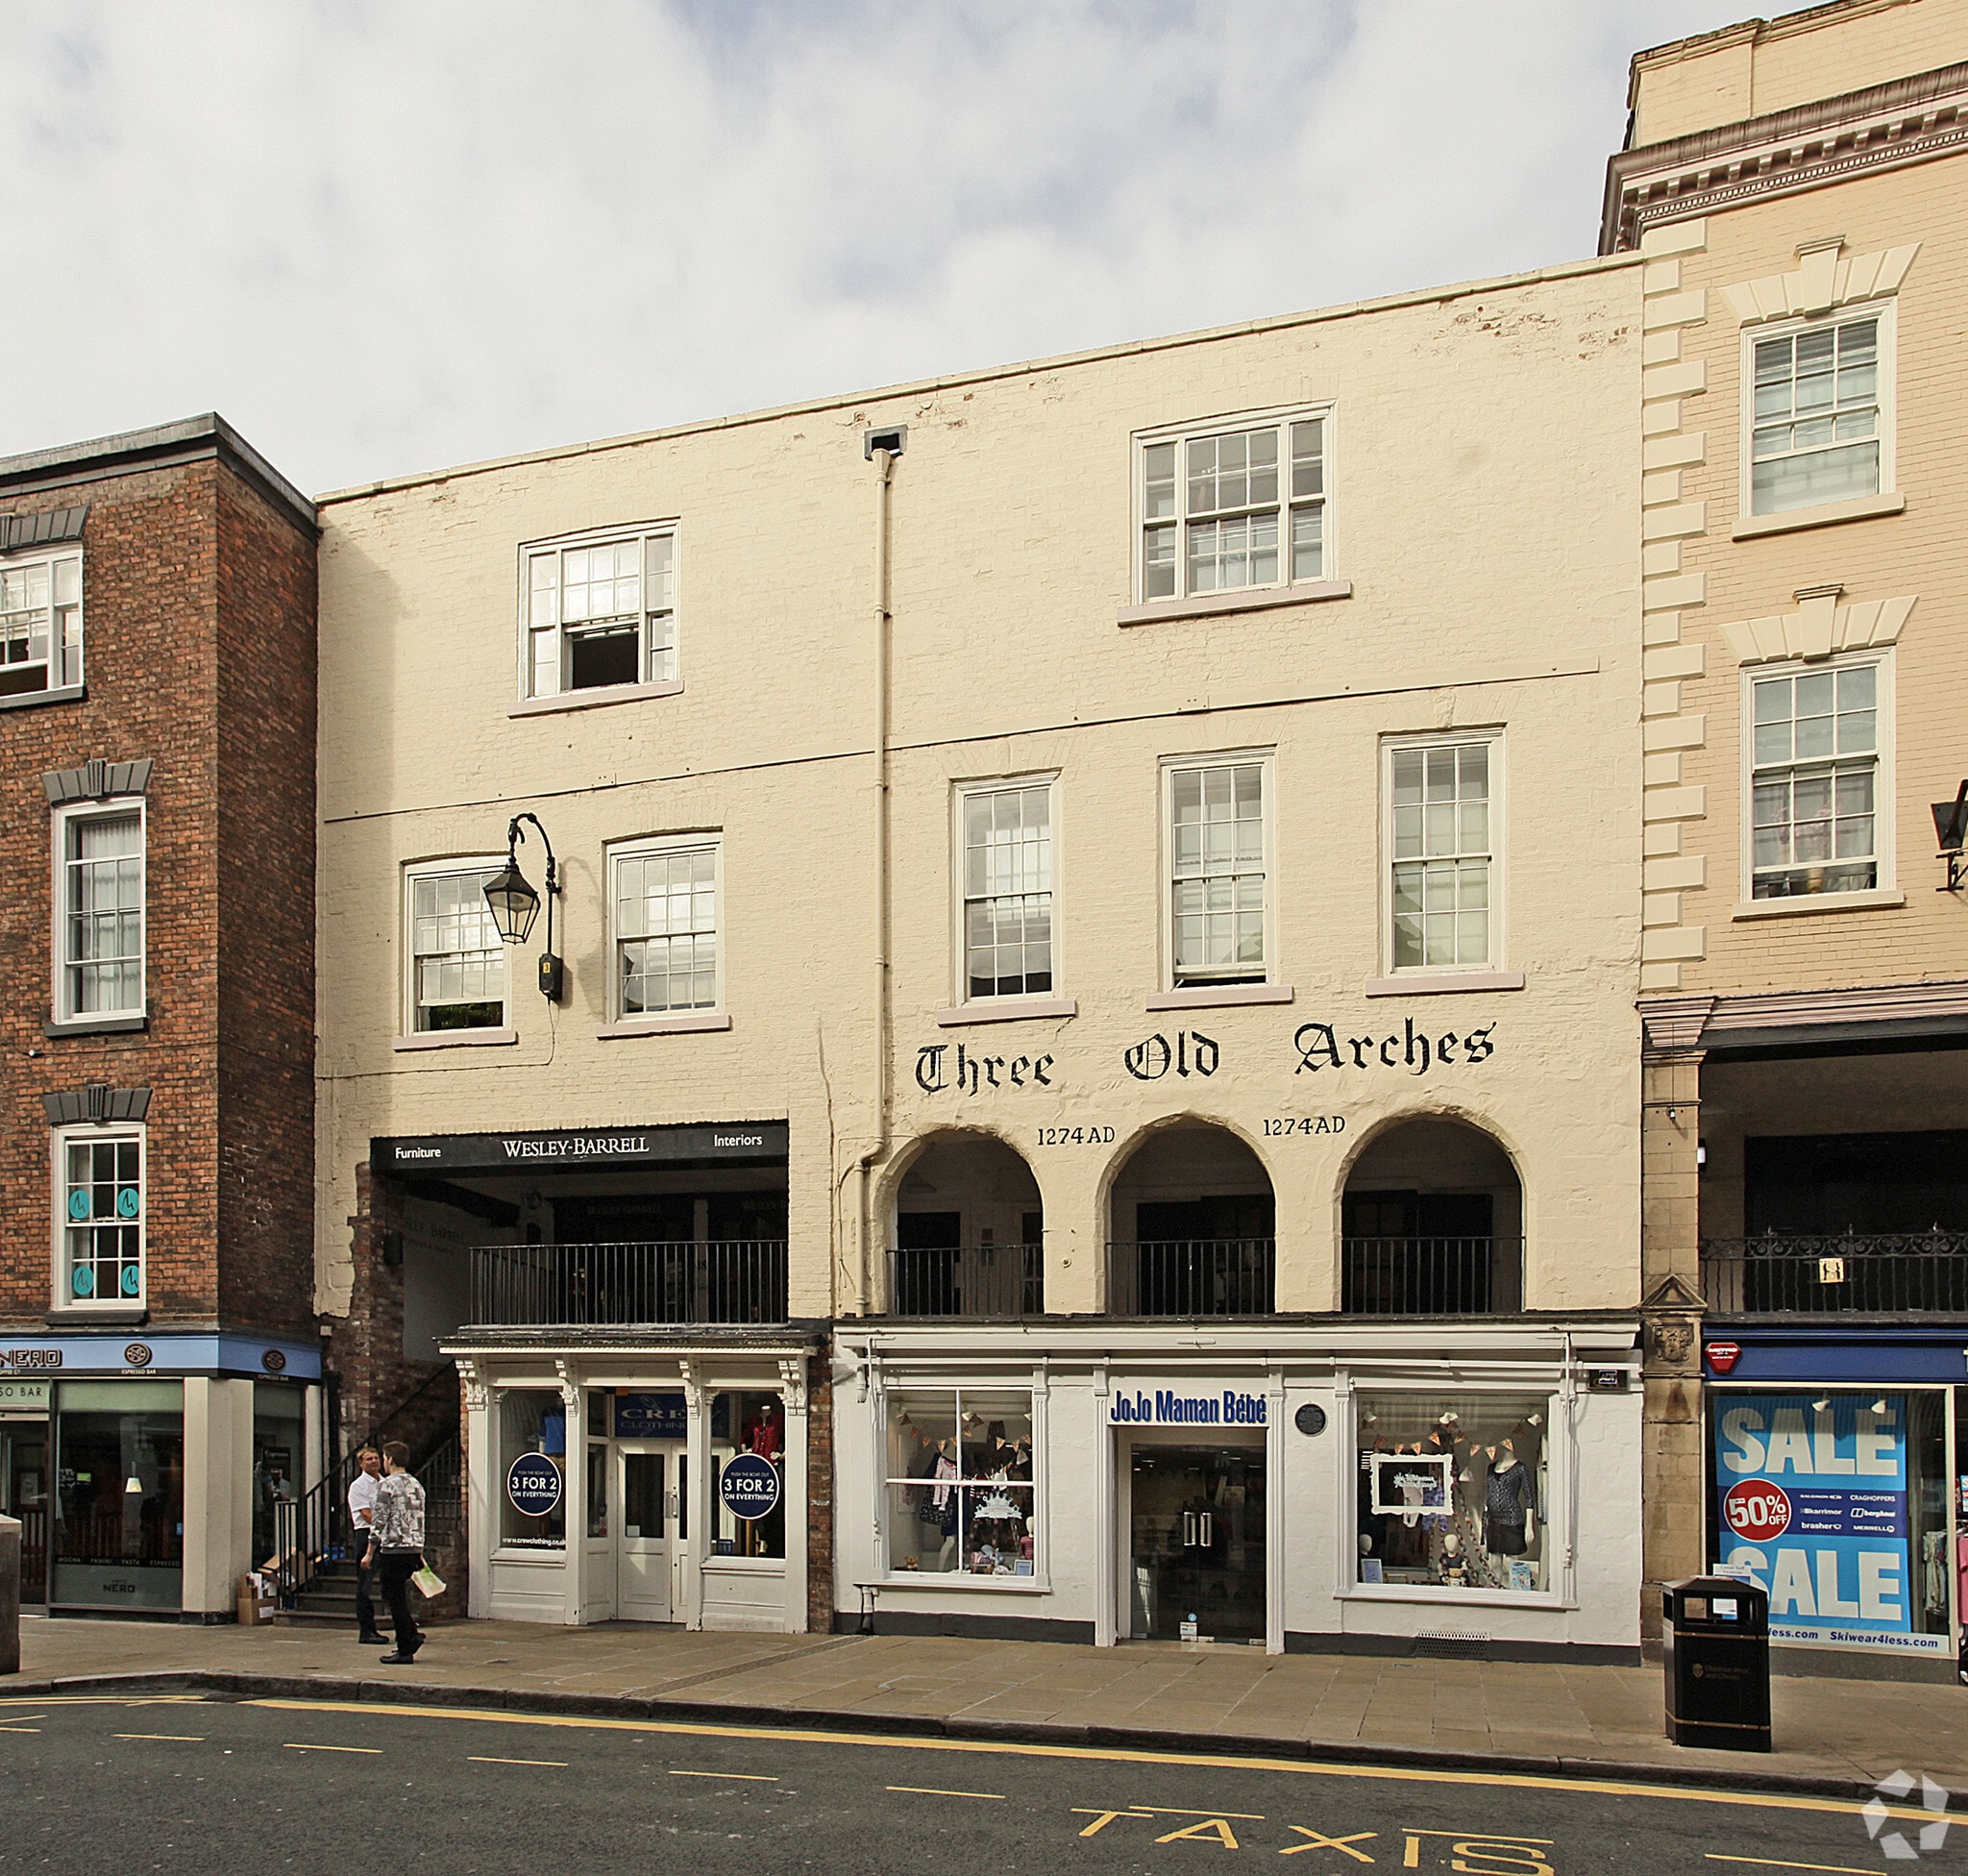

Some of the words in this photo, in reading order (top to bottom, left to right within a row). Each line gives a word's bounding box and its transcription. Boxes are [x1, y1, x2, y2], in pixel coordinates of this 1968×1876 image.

[915, 1043, 1054, 1098] Three
[1123, 1030, 1220, 1081] Old
[1293, 1017, 1497, 1077] Arches
[1263, 1115, 1346, 1137] 1274AD
[1037, 1124, 1116, 1147] 1274AD
[395, 1146, 442, 1160] Furniture
[502, 1137, 651, 1158] WESLEY-BARRELL
[713, 1134, 763, 1148] Interiors
[19, 1387, 42, 1397] BAR
[621, 1409, 721, 1419] CRE
[1110, 1390, 1152, 1422] JoJo
[1155, 1390, 1220, 1423] Maman
[1222, 1390, 1267, 1424] Bébé
[1721, 1408, 1899, 1476] SALE
[511, 1476, 520, 1490] 3
[522, 1476, 547, 1490] FOR
[549, 1477, 557, 1490] 2
[724, 1478, 732, 1492] 3
[736, 1478, 763, 1493] FOR
[766, 1478, 775, 1493] 2
[522, 1491, 557, 1499] EVERYTHING
[736, 1493, 775, 1501] EVERYTHING
[1728, 1494, 1787, 1528] 50%
[1768, 1515, 1788, 1526] OFF
[1801, 1521, 1833, 1530] brasher
[102, 1583, 135, 1593] NERO
[1829, 1631, 1939, 1648] Skiwear4less.com
[1070, 1808, 1555, 1876] TAXIS
